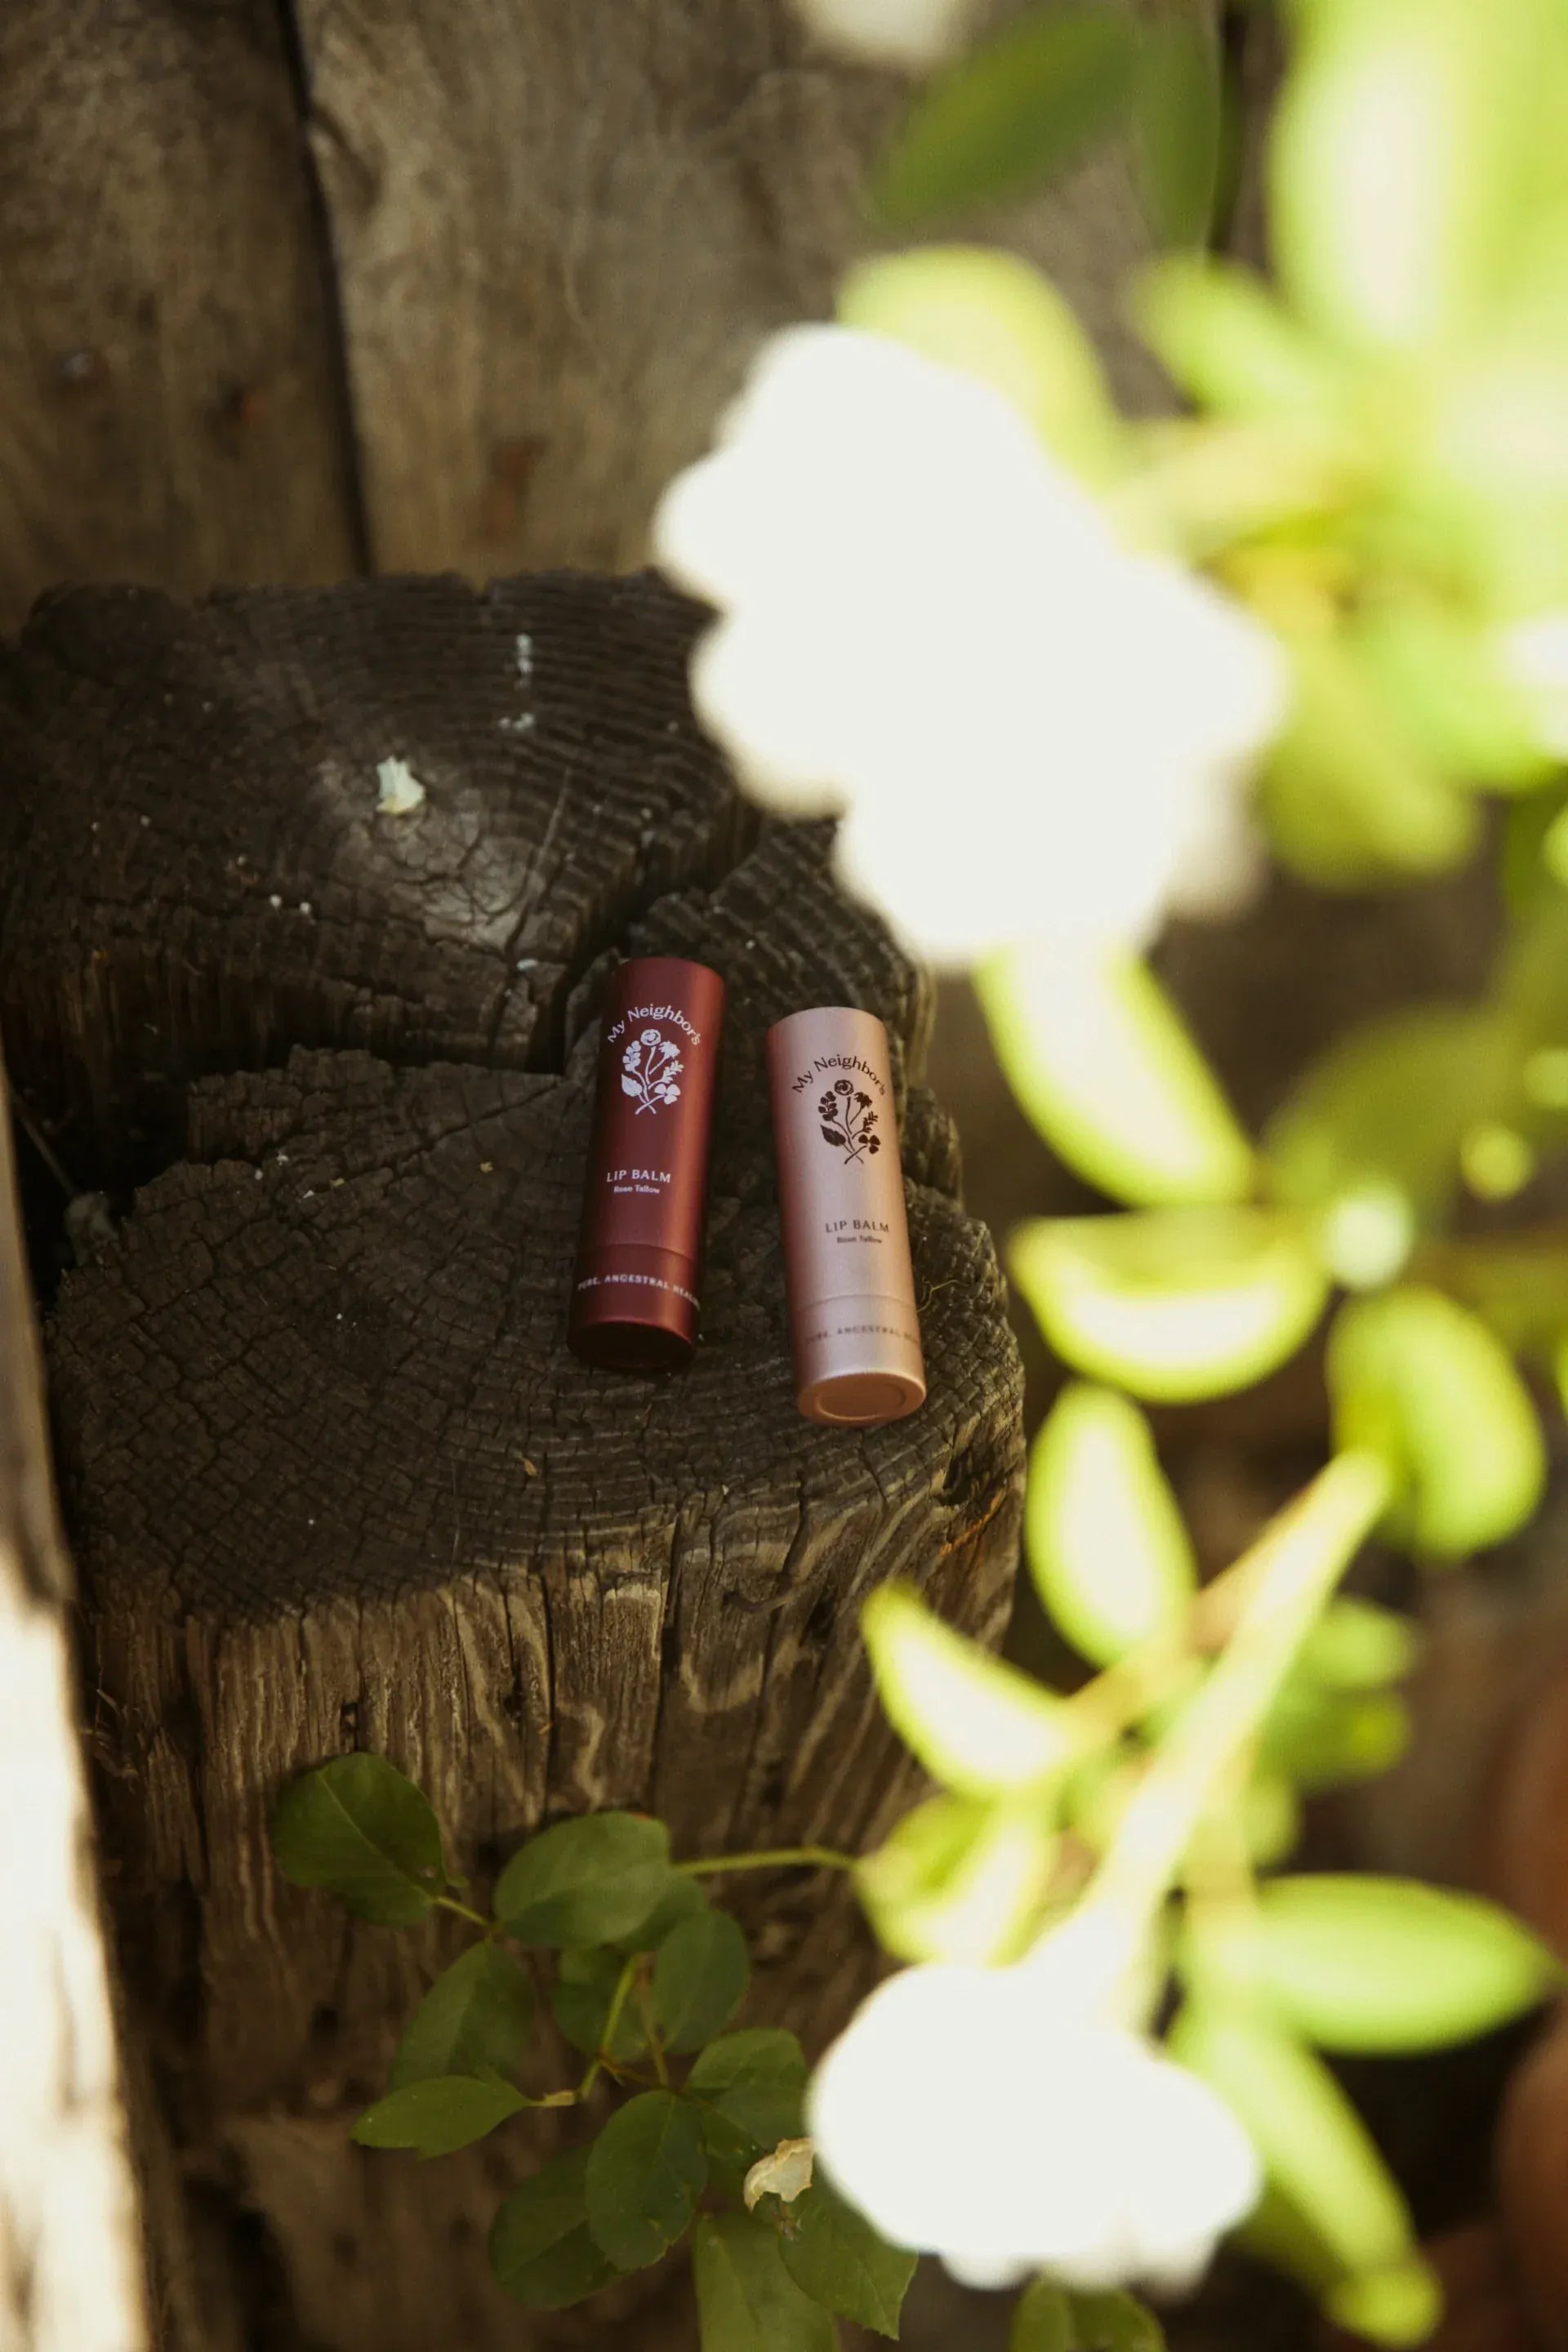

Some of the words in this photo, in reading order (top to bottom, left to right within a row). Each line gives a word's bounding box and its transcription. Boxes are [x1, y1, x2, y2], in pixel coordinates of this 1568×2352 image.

[607, 1020, 625, 1042] My
[626, 1003, 701, 1045] Neighbor's
[791, 1071, 813, 1093] My
[813, 1054, 886, 1095] Neighbor's
[606, 1169, 627, 1183] LIP
[631, 1169, 671, 1183] BALM
[825, 1220, 847, 1233] LIP
[853, 1219, 889, 1232] BALM
[604, 1274, 669, 1290] ANCESTRAL
